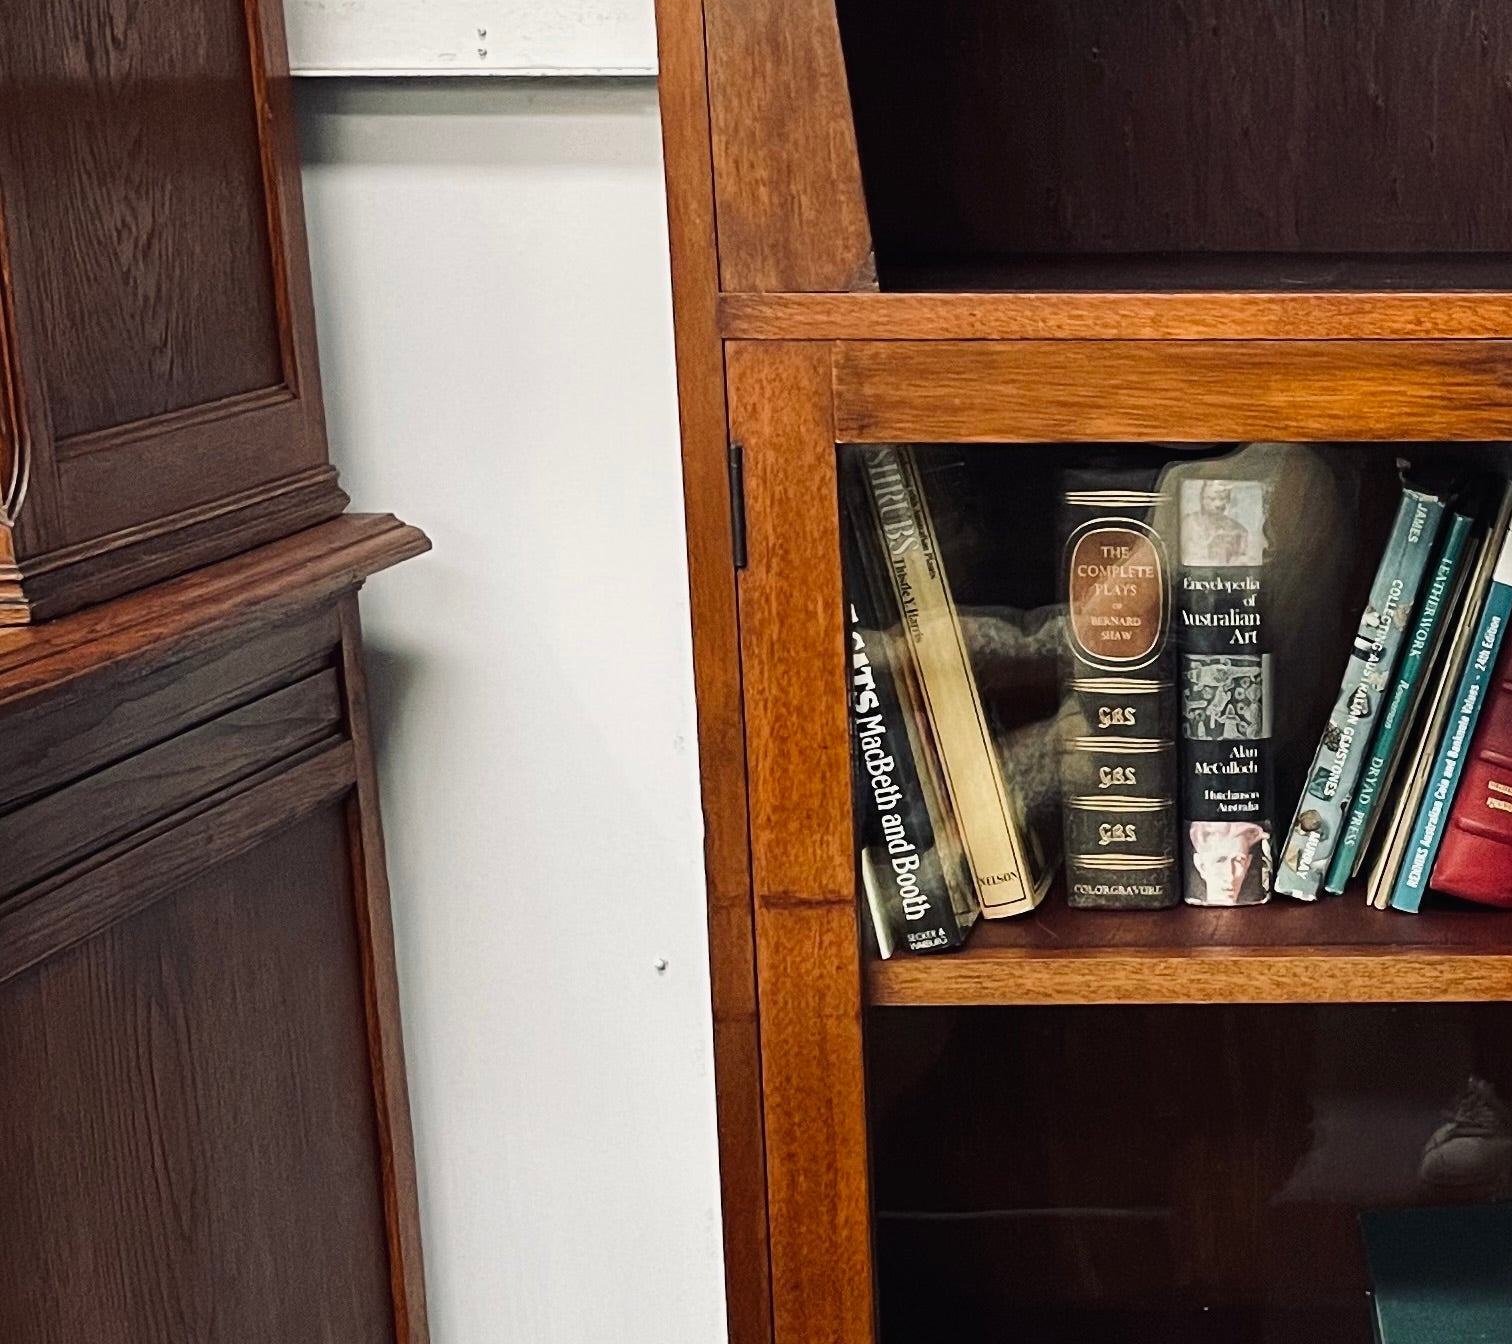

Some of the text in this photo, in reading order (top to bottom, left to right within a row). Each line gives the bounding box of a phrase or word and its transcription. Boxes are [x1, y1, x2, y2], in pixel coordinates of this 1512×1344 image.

[867, 448, 919, 556] SHRUBS
[1408, 502, 1428, 543] JAMES
[1100, 546, 1130, 558] THE
[1077, 564, 1154, 578] COMPLETE
[1094, 582, 1137, 595] PLAYS
[1183, 576, 1260, 594] Encyclopedia
[892, 558, 913, 596] Thistle
[906, 607, 924, 644] Harris
[1243, 593, 1257, 607] of
[1090, 616, 1142, 626] BERNARD
[1182, 608, 1260, 626] Australian
[1101, 630, 1132, 640] SHAW
[1229, 628, 1257, 644] Art
[1481, 615, 1502, 650] Edition
[1474, 649, 1491, 672] 24th
[1323, 579, 1404, 797] COLLECTING AUSTRALIAN GEMSTONES
[1460, 684, 1480, 714] Values
[1229, 744, 1258, 758] Alan
[856, 713, 903, 811] MacBeth
[1194, 760, 1258, 774] McCulloch
[1443, 758, 1457, 778] and
[1204, 789, 1260, 800] Hutchinson
[1434, 778, 1450, 800] Coin
[1216, 801, 1259, 812] Australia
[1344, 757, 1384, 846] DRYAD PRESS
[881, 813, 916, 855] and
[1419, 801, 1444, 848] Australian
[891, 853, 932, 921] Booth
[978, 871, 1020, 887] NELSON
